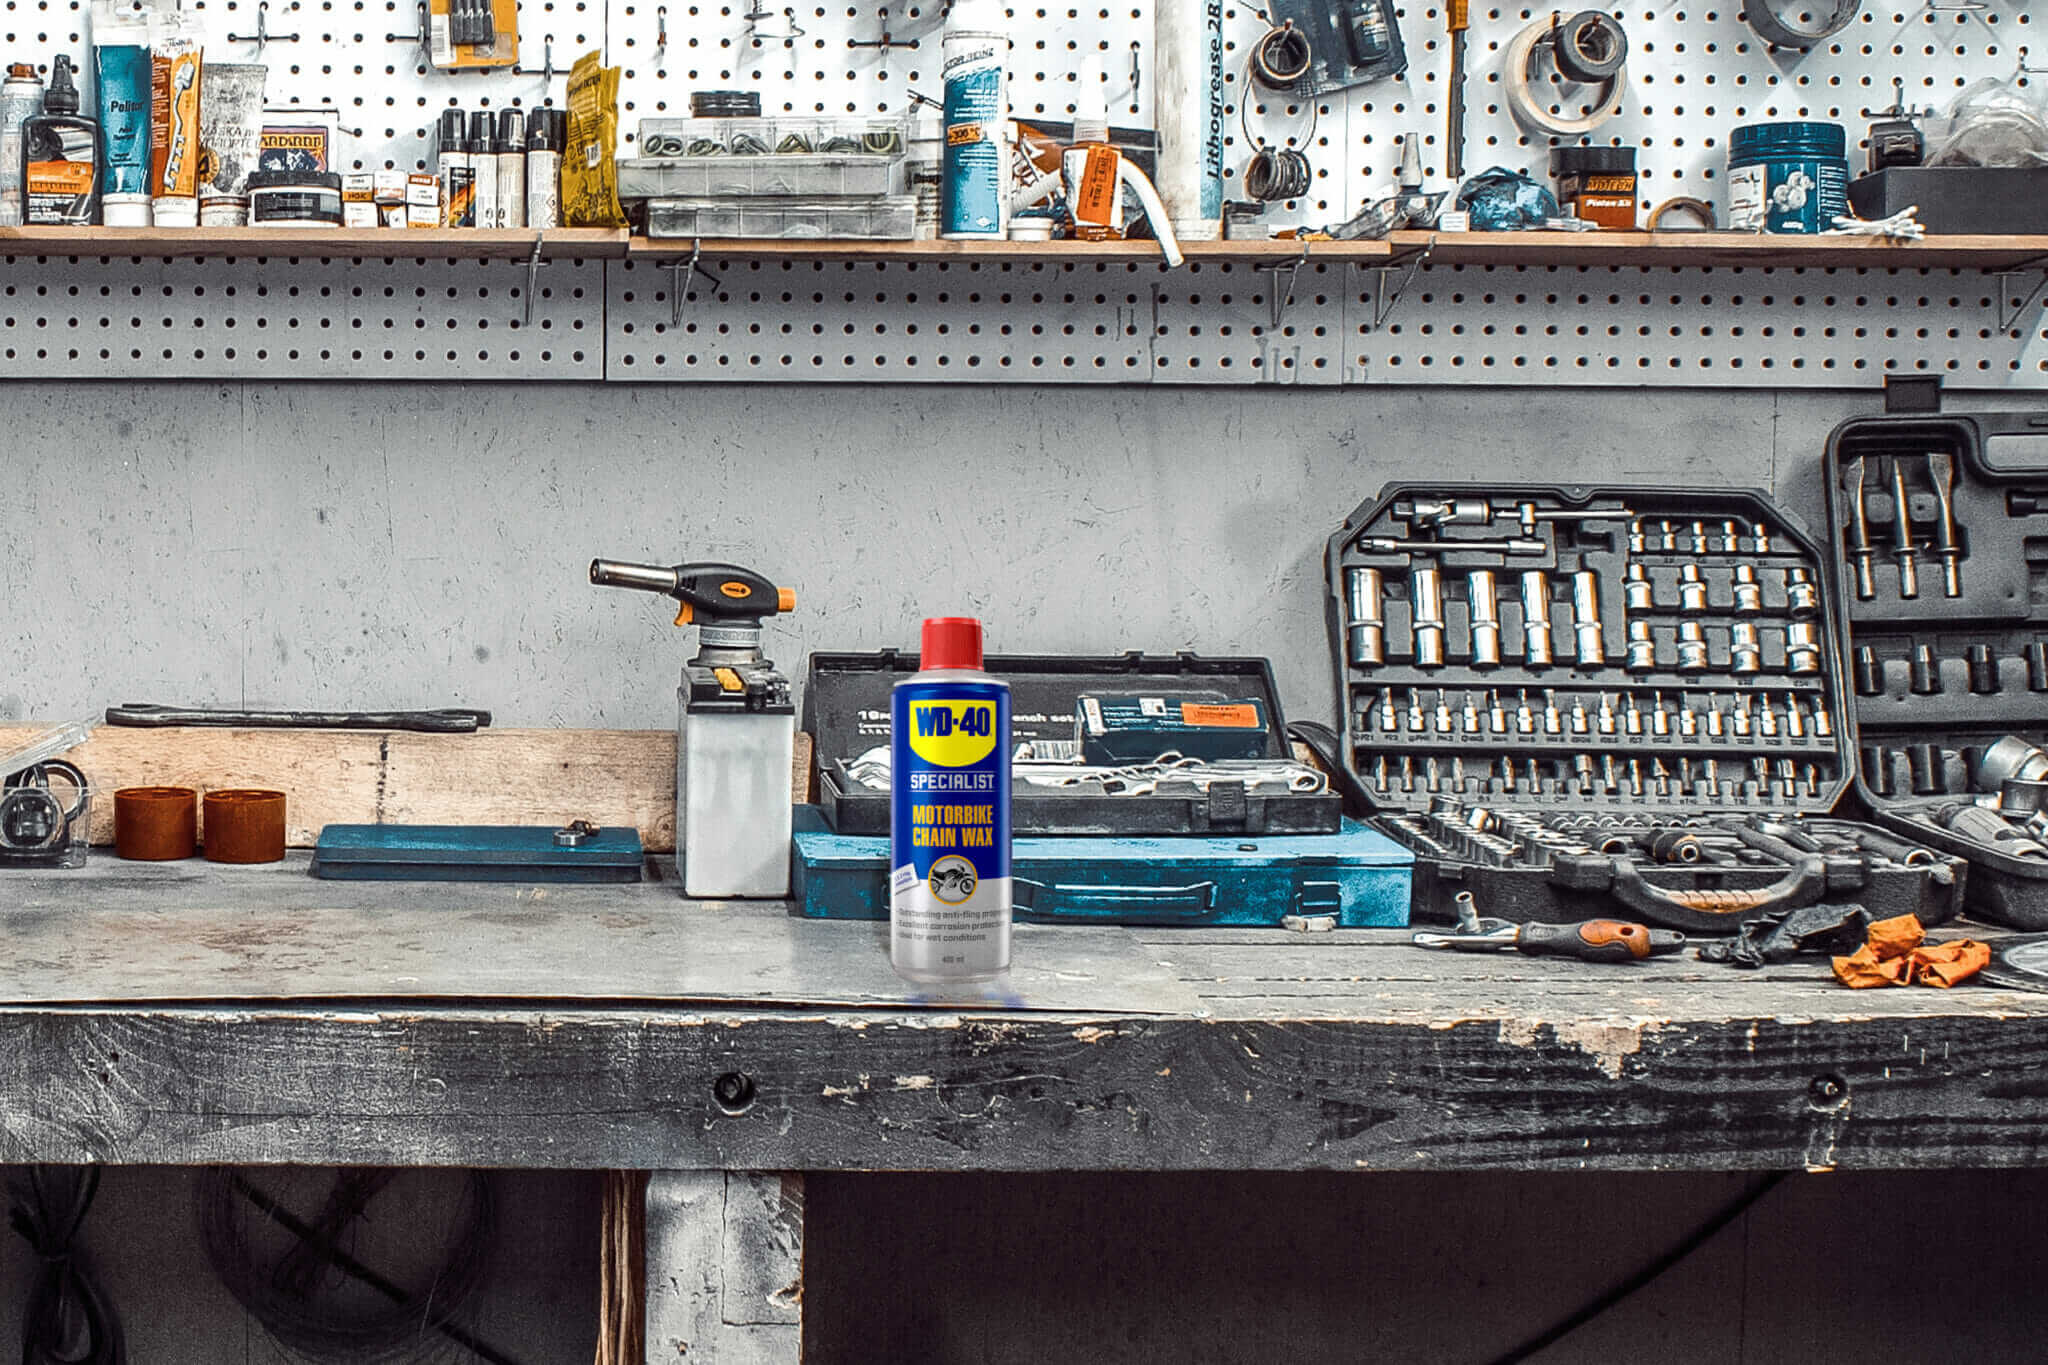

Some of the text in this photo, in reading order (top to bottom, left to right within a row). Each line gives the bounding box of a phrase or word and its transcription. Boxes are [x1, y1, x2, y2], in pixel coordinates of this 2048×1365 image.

[1206, 3, 1223, 180] Lithogrease 2B
[915, 706, 991, 737] WD-40
[910, 774, 995, 790] SPECIALIST
[912, 804, 993, 825] MOTORBIKE
[912, 827, 993, 847] CHAIN WAX
[942, 911, 981, 919] anti-fling
[926, 934, 942, 942] wet
[943, 933, 987, 942] conditions
